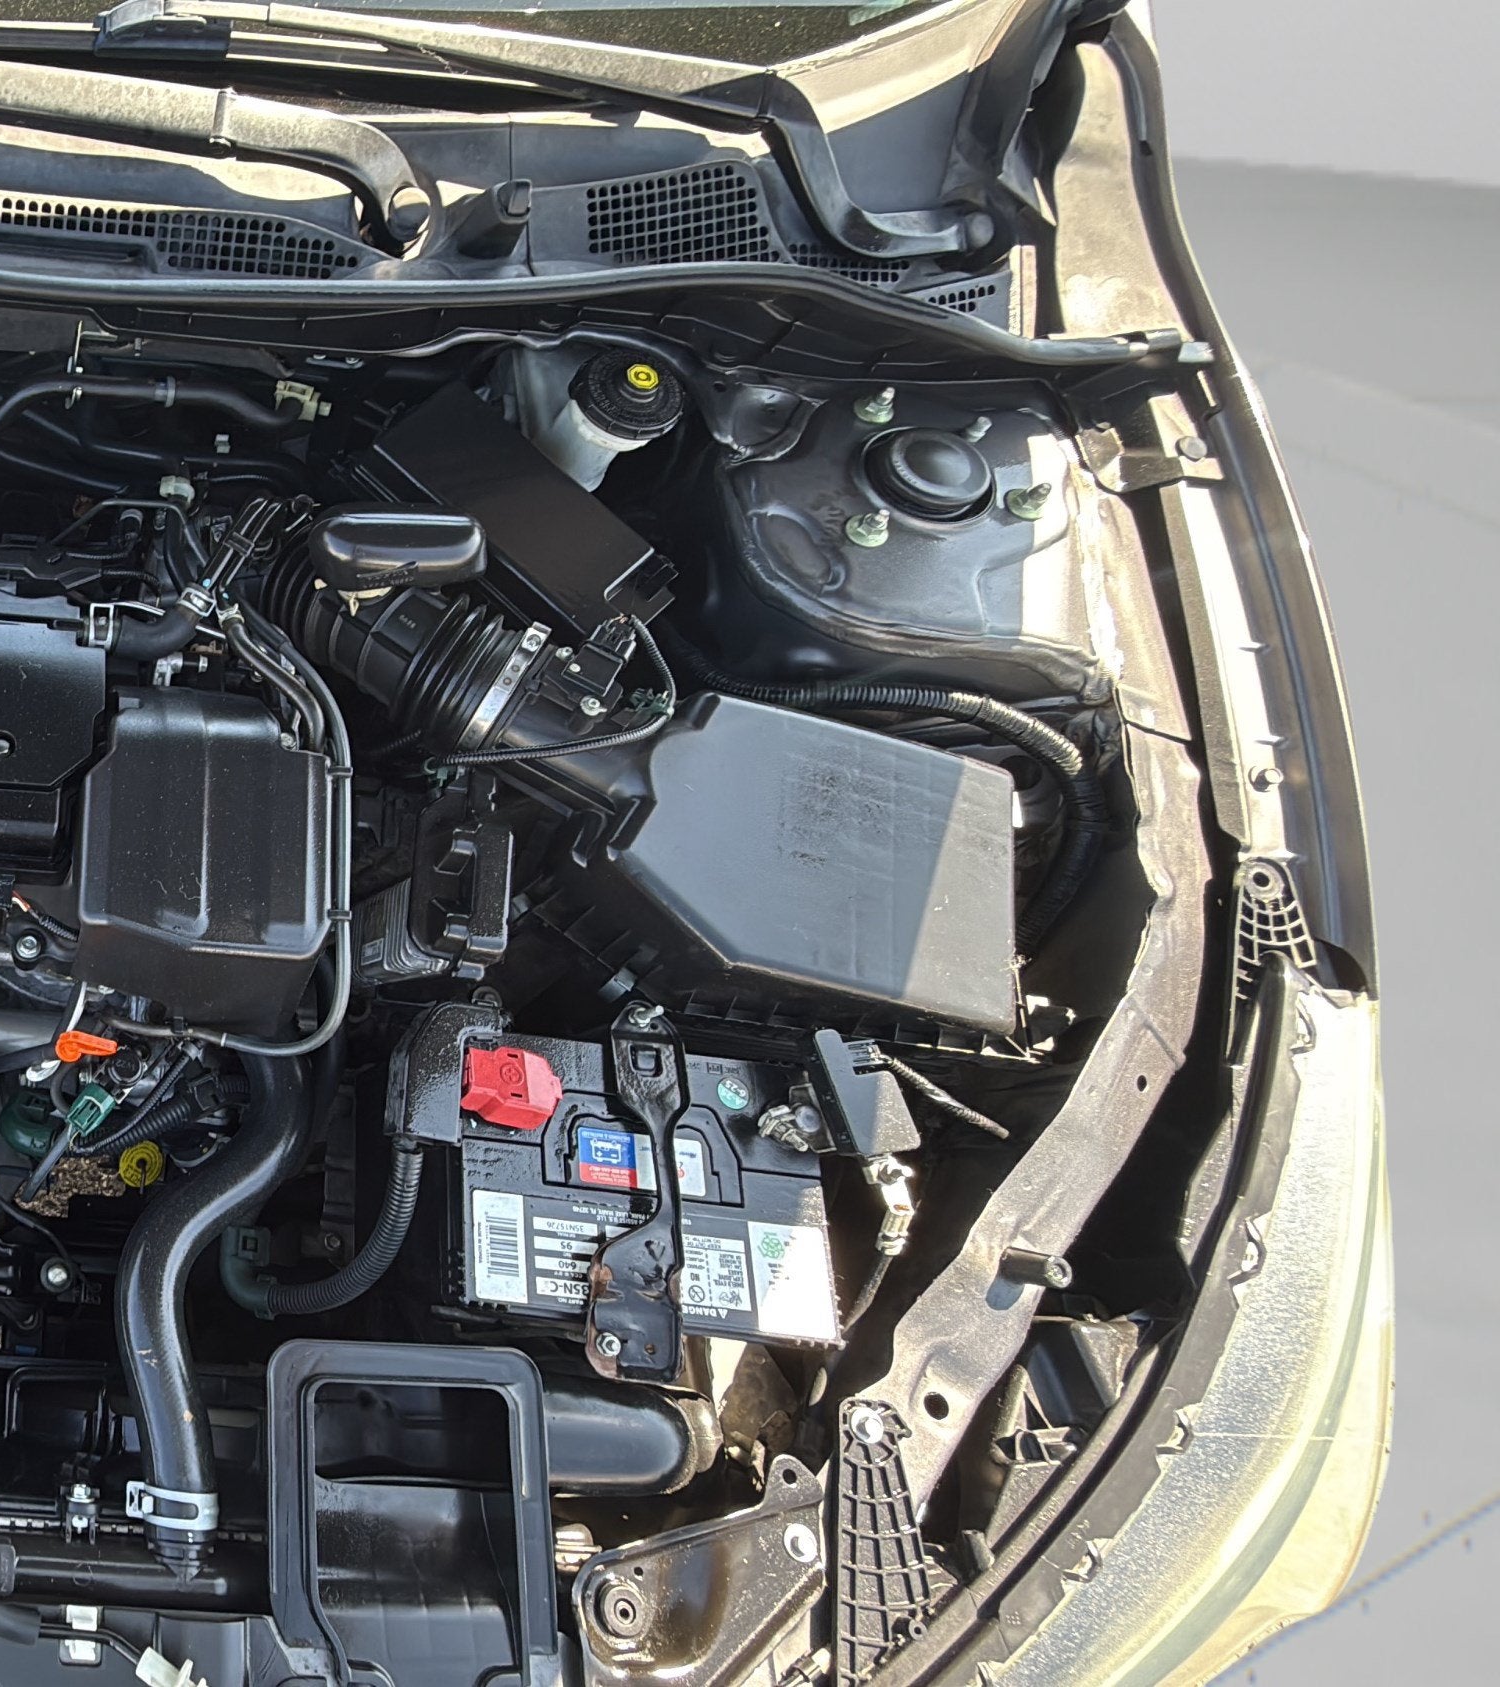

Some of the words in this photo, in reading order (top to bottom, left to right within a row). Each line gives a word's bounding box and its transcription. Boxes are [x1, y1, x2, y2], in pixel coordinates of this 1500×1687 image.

[724, 1080, 746, 1098] 6-25
[561, 1241, 572, 1249] 95
[558, 1260, 576, 1269] 640
[549, 1280, 589, 1297] 35N-C
[682, 1305, 717, 1317] DANGE
